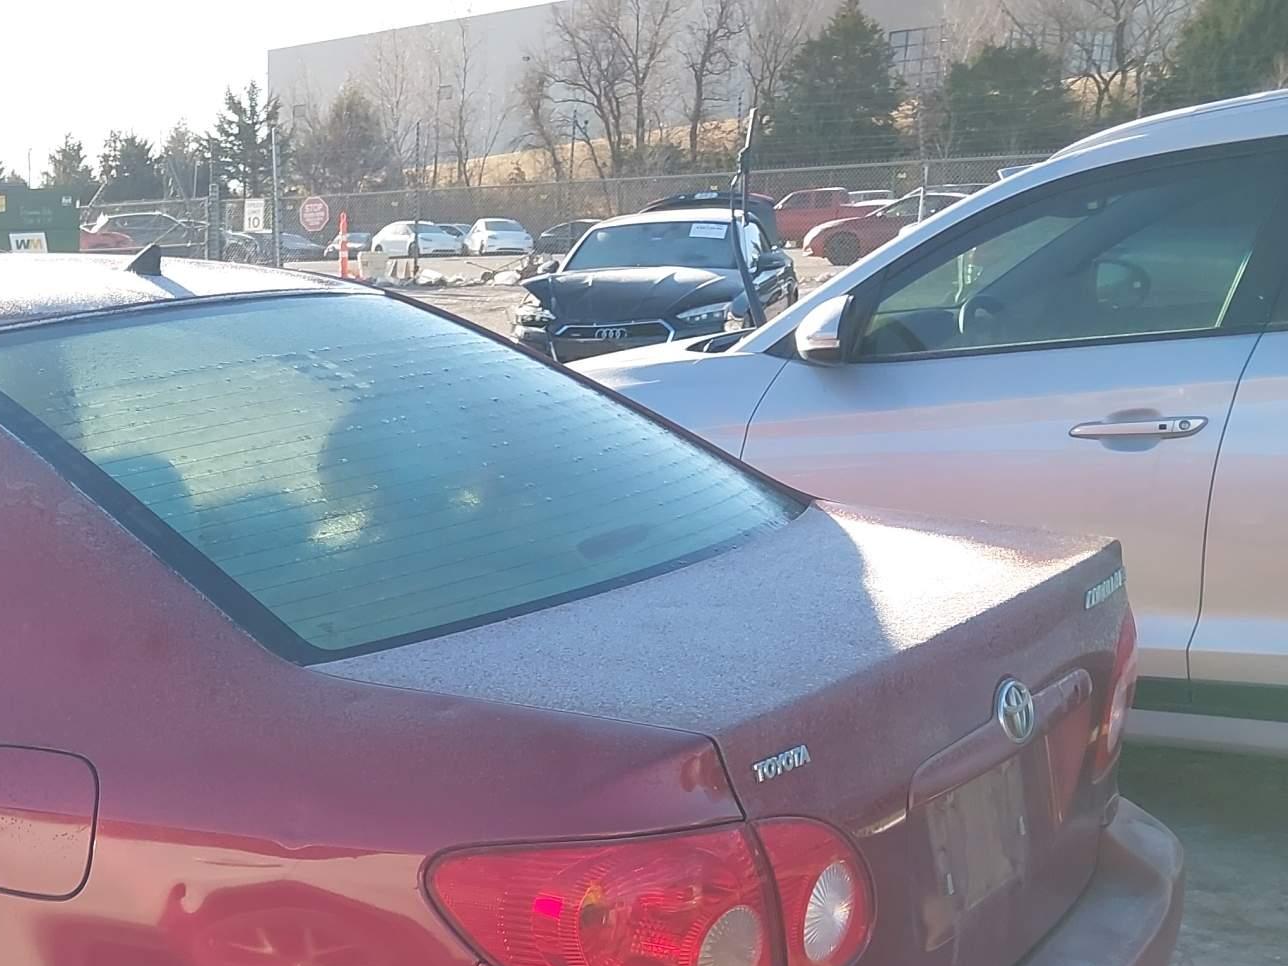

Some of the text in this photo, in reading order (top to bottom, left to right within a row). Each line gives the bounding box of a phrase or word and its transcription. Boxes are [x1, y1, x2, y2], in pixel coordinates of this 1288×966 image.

[304, 203, 323, 213] STOP
[248, 217, 260, 229] 10
[15, 239, 41, 250] WM
[753, 744, 811, 782] TOYOTA
